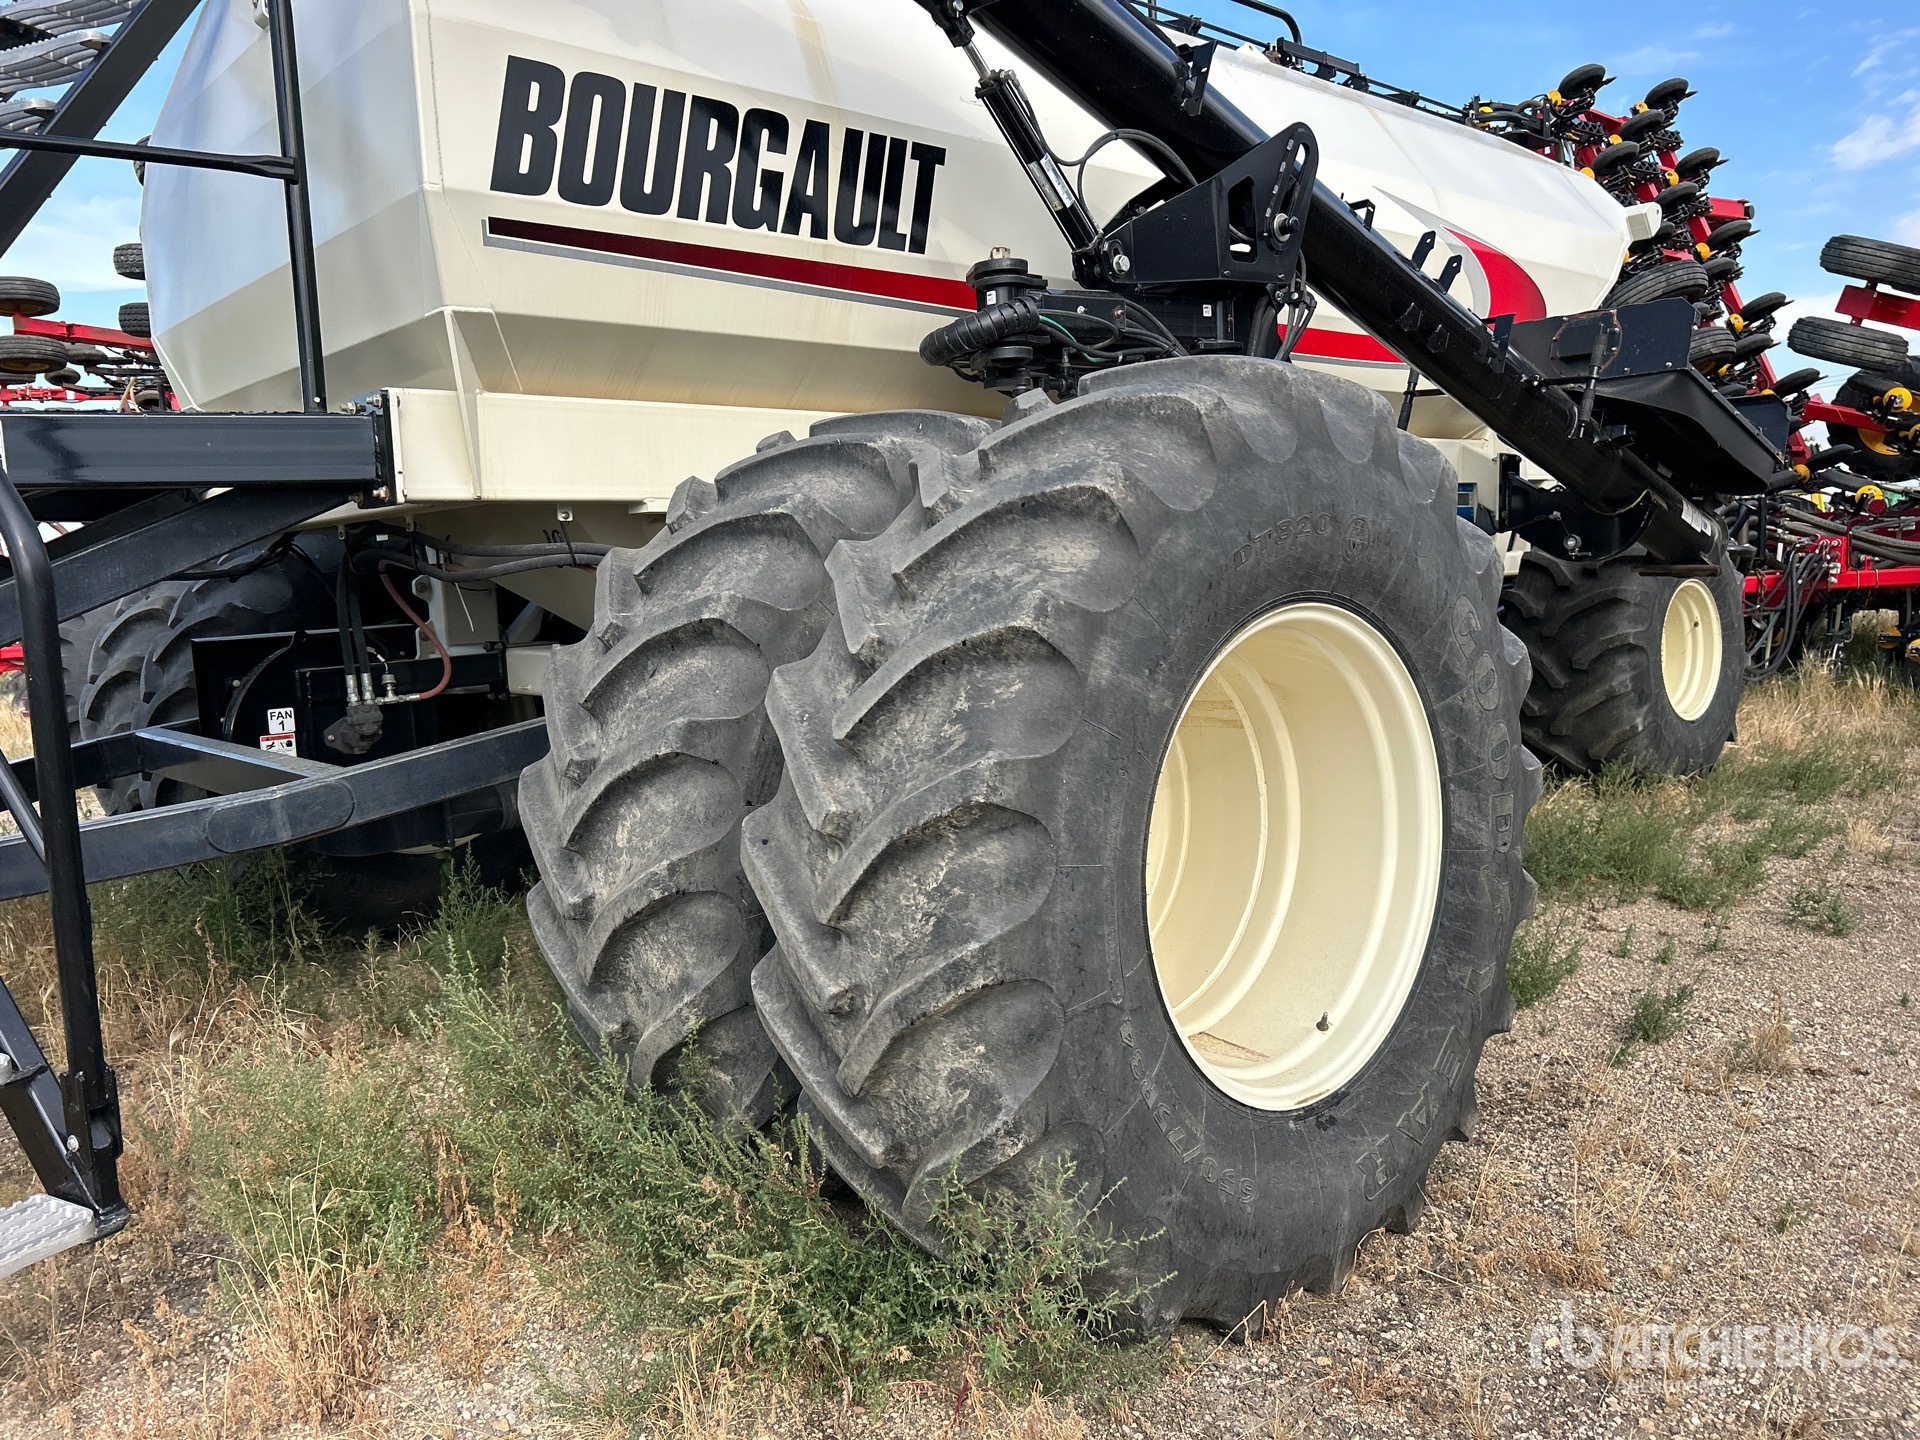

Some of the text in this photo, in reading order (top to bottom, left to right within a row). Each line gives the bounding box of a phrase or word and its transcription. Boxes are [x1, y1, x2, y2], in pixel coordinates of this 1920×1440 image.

[490, 54, 947, 255] BOURGAULT
[1232, 512, 1333, 571] DT820
[270, 710, 292, 720] FAN
[279, 720, 285, 731] 1
